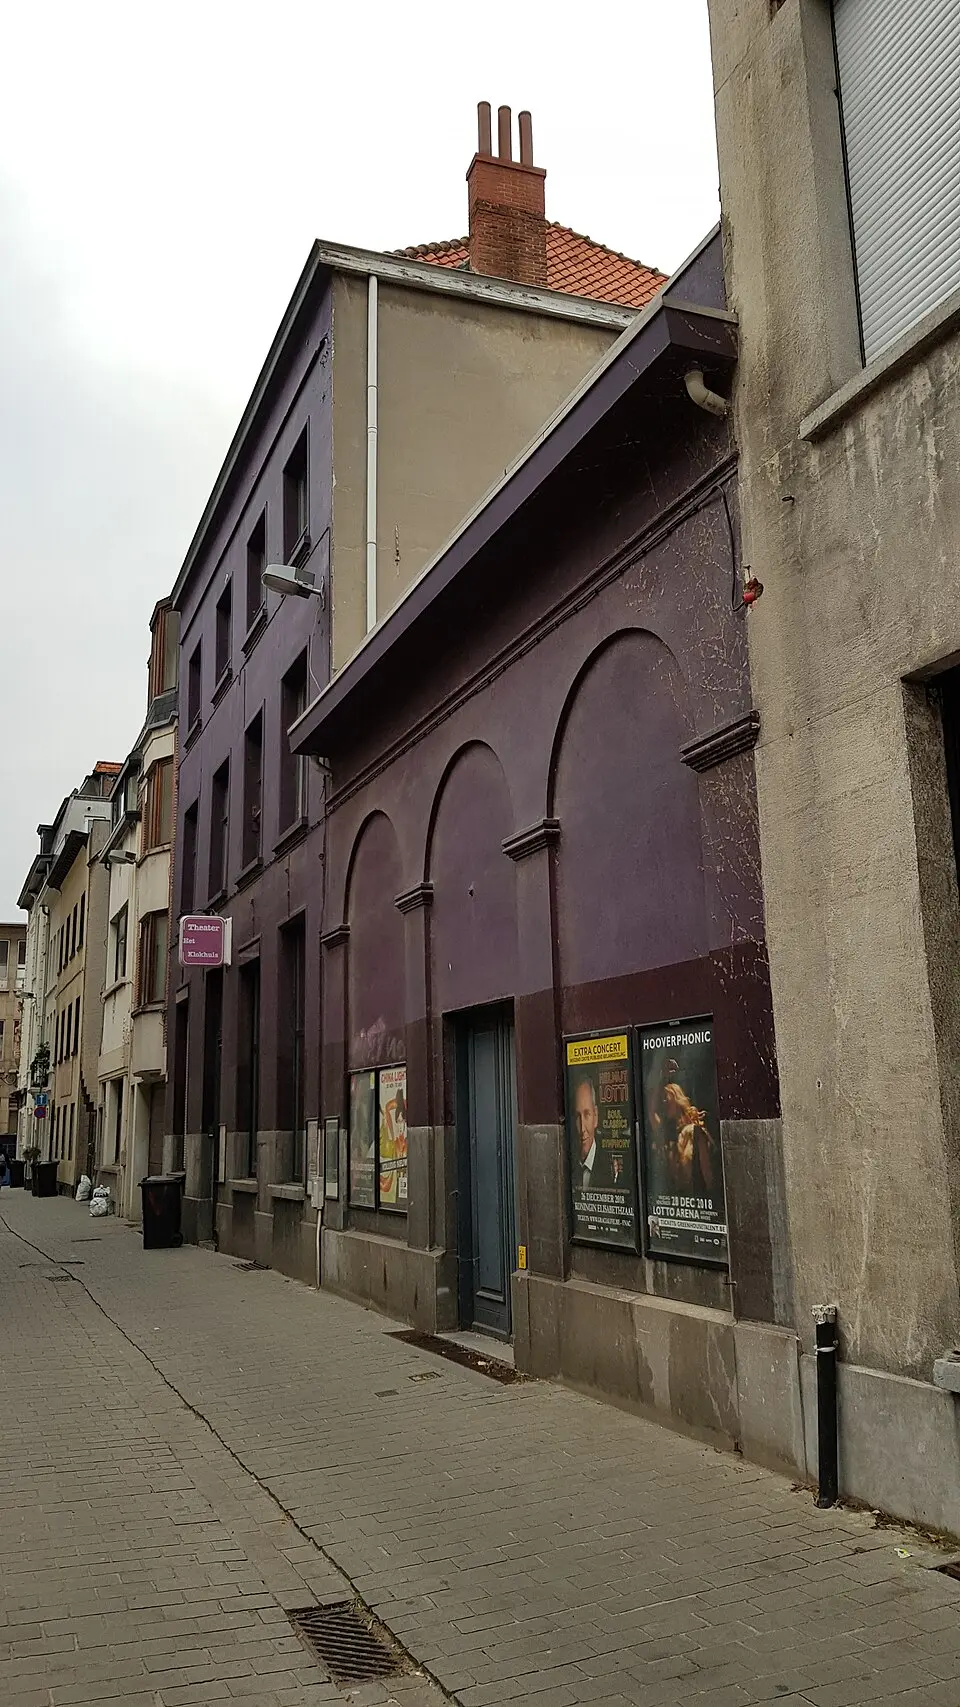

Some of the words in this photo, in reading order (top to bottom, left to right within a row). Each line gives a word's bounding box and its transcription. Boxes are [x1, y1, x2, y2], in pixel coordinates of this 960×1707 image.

[644, 1031, 711, 1050] HOOVERPHONIC
[574, 1046, 592, 1056] EXTRA
[593, 1042, 621, 1054] CONCERT
[600, 1084, 629, 1102] LOTTI
[586, 1193, 614, 1203] DECEMBER
[671, 1196, 679, 1206] 28
[680, 1197, 696, 1208] DEC
[696, 1199, 713, 1209] 2018
[575, 1202, 597, 1212] KONINGIN
[598, 1205, 634, 1216] ELISABETHZAAL
[652, 1206, 675, 1216] LOTTO
[676, 1208, 700, 1219] ARENA
